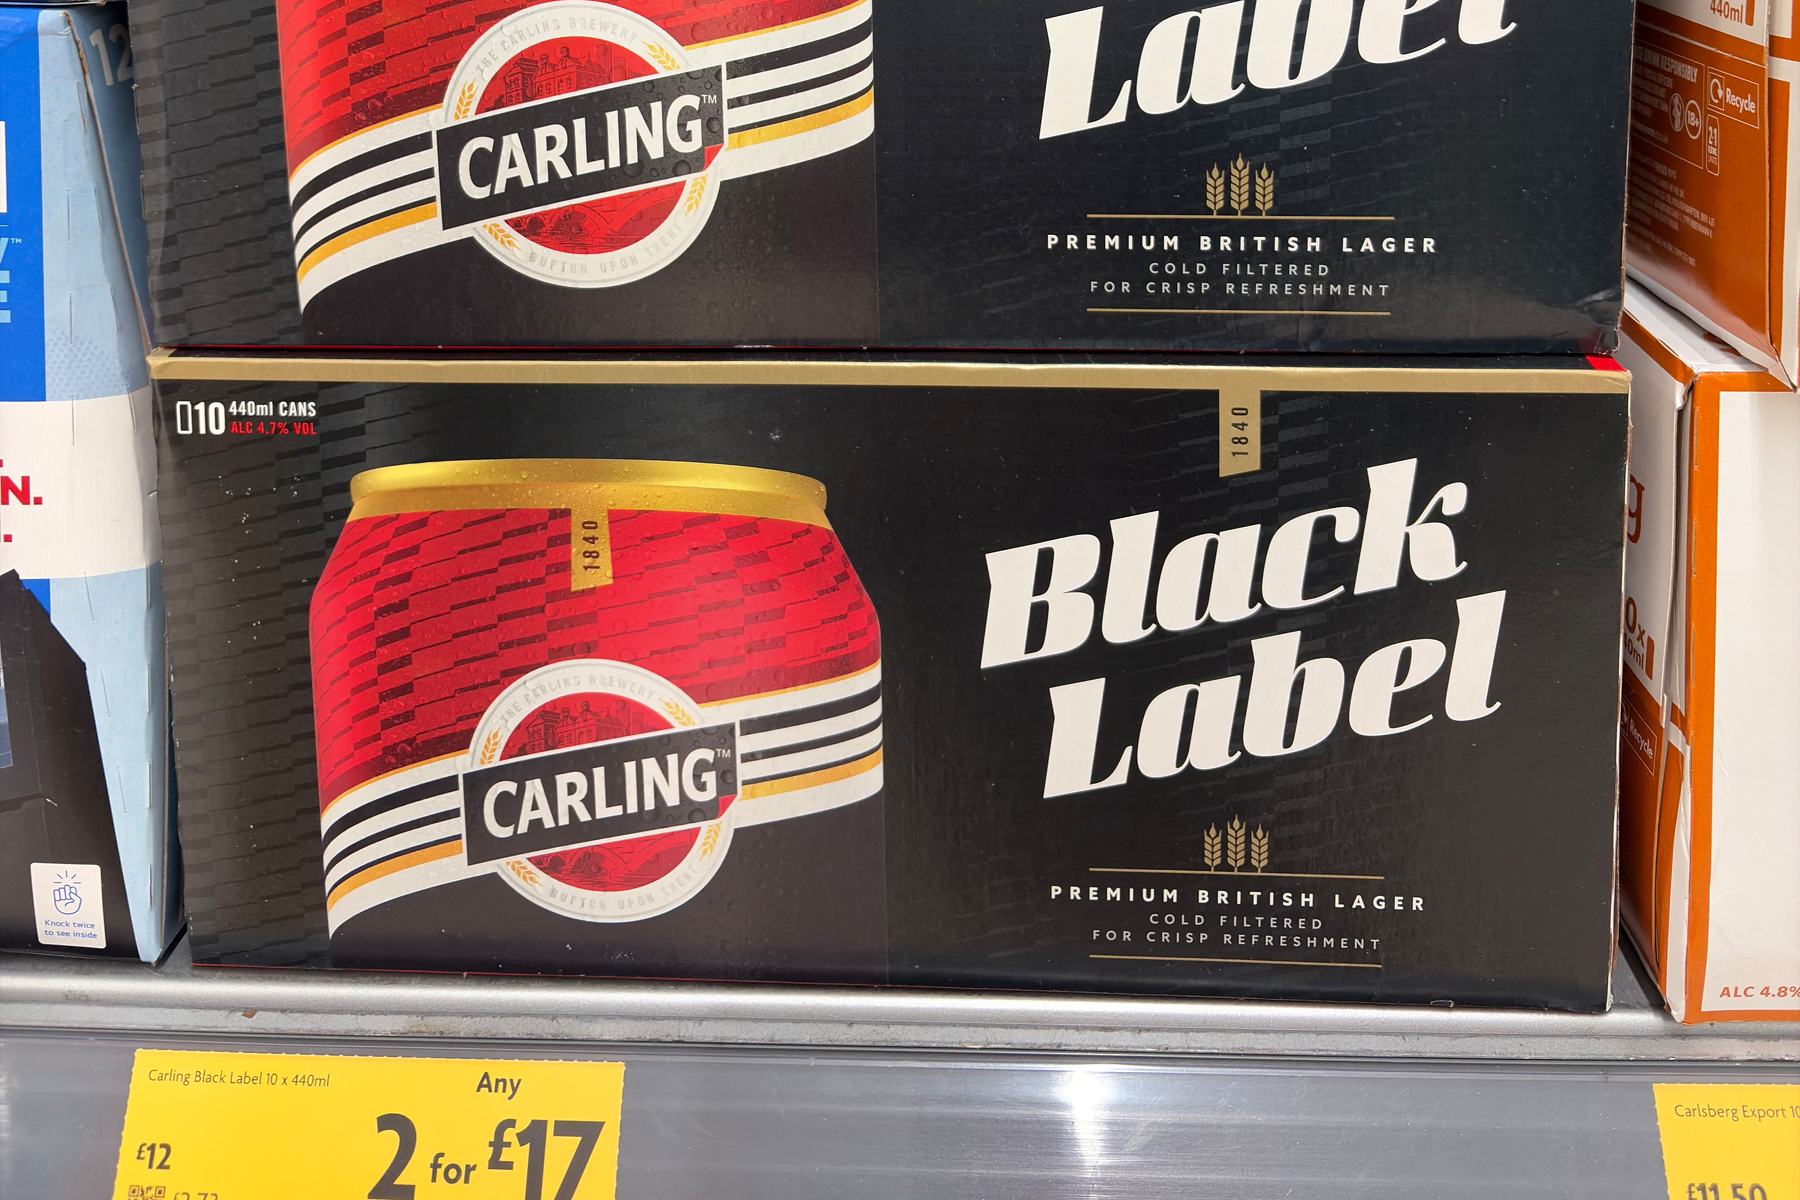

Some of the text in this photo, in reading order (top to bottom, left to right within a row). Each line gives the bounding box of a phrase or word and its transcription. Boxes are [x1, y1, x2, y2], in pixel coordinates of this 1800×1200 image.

[474, 17, 639, 74] THE CARLING BREWERY
[1725, 87, 1756, 114] Recycle
[1687, 110, 1699, 127] 18+
[459, 94, 703, 199] CARLING
[1708, 145, 1717, 156] UK
[1047, 234, 1437, 253] PREMIUM BRITISH LAGER
[600, 254, 639, 273] UPON
[1149, 262, 1329, 276] COLD FILTERED
[1090, 281, 1389, 297] FOR CRISP REFRESHMENT
[194, 400, 317, 435] 10 440ml CANS
[230, 421, 317, 435] ALC 4.7% VOL
[1231, 406, 1249, 458] 1840
[581, 521, 600, 571] 1840
[980, 457, 1468, 669] Black
[500, 674, 655, 723] THE CARLING BREWERY
[1043, 590, 1507, 799] Label
[1629, 716, 1653, 759] Recycle
[483, 748, 717, 838] CARLING
[618, 894, 655, 910] UPON
[1051, 885, 1425, 911] PREMIUM BRITISH LAGER
[44, 919, 95, 929] Knock twice
[1149, 914, 1323, 930] COLD FILTERED
[73, 931, 98, 939] inside
[1092, 930, 1380, 950] FOR CRISP REFRESHMENT
[1719, 986, 1755, 998] ALC
[148, 1069, 330, 1087] Carling Black Label 10 x 440ml
[476, 1071, 521, 1100] Any
[1674, 1104, 1739, 1122] Carlsberg
[1742, 1105, 1786, 1122] Export
[136, 1142, 172, 1170] £12
[367, 1112, 606, 1200] 2 for £17
